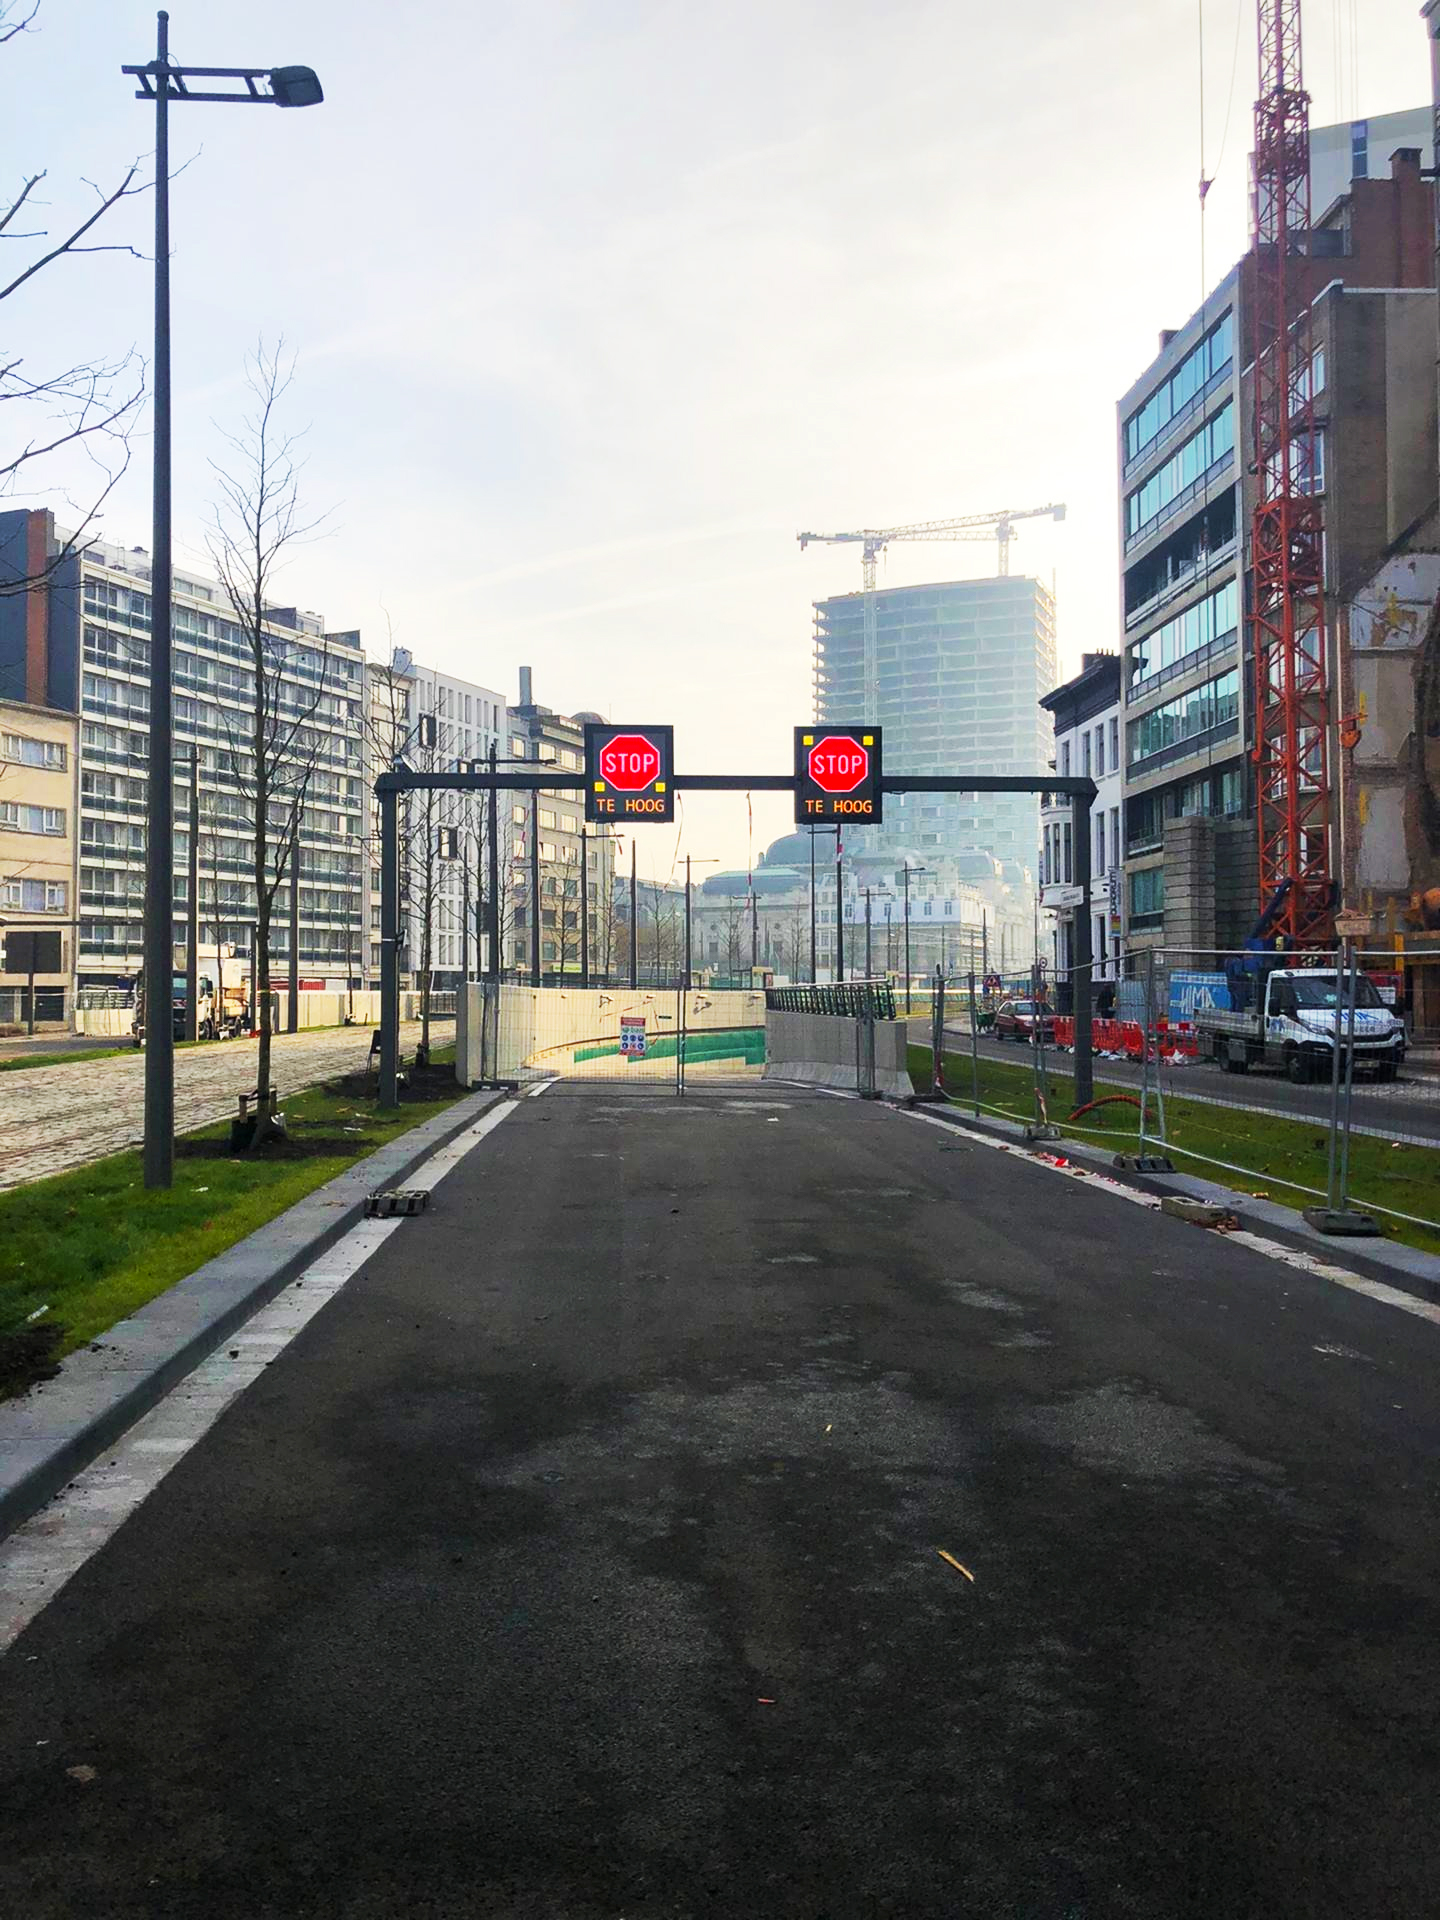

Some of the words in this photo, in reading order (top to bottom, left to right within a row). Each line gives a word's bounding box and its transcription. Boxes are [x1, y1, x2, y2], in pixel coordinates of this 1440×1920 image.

[605, 752, 655, 773] STOP
[814, 754, 863, 775] STOP
[596, 798, 616, 813] TE
[624, 798, 666, 813] HOOG
[805, 799, 824, 814] TE
[833, 799, 873, 814] HOOG
